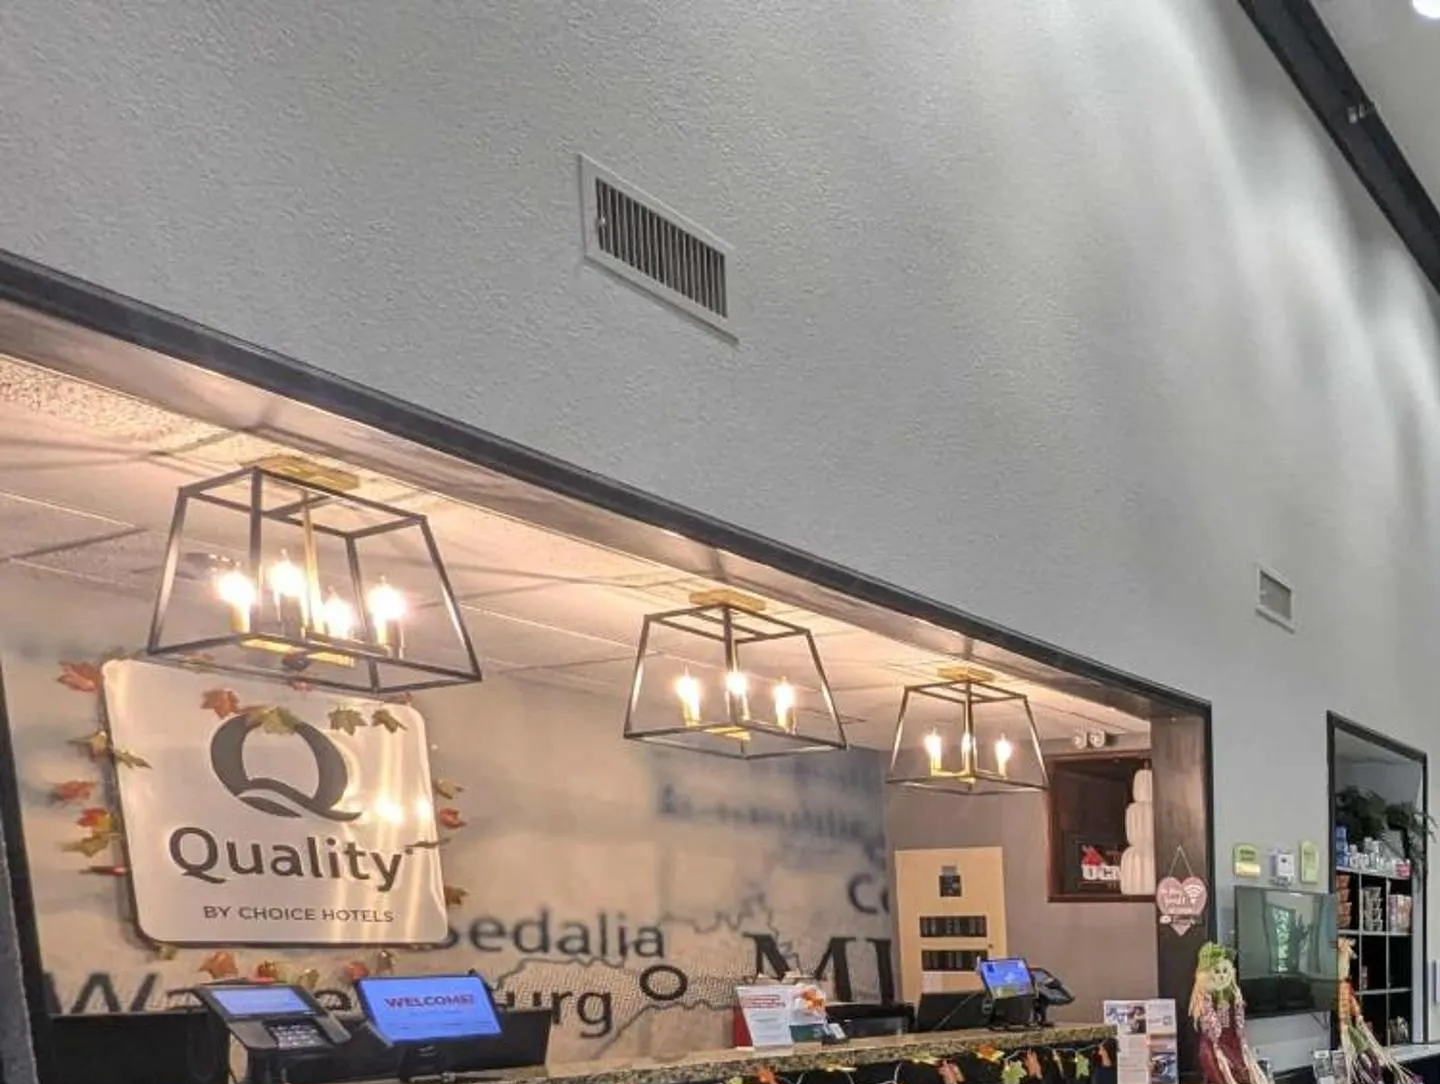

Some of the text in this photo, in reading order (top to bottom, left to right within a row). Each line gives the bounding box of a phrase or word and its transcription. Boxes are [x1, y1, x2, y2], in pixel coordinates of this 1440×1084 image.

[210, 711, 363, 822] Q
[168, 826, 403, 892] Quality
[203, 905, 395, 923] BY CHOICE HOTELS
